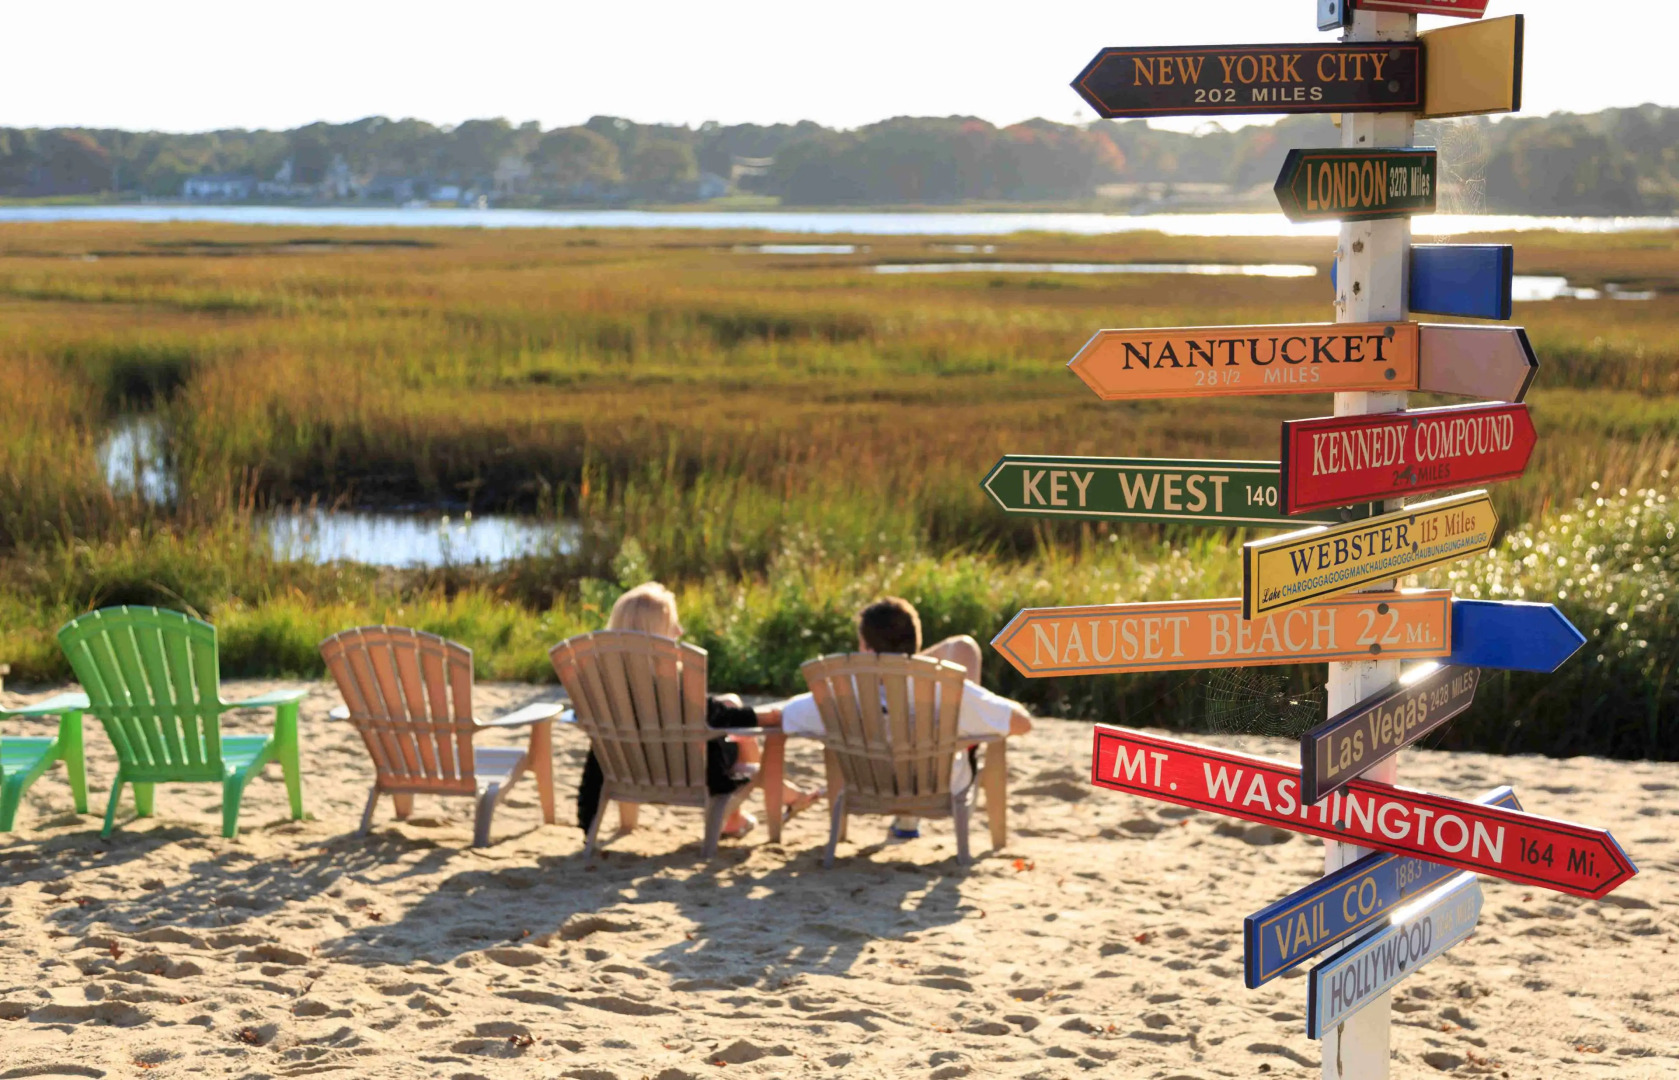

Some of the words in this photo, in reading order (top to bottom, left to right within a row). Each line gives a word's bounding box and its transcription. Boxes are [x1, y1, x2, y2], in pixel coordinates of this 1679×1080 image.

[1132, 56, 1205, 86] NEW
[1218, 54, 1303, 84] YORK
[1317, 52, 1388, 82] CITY
[1194, 88, 1236, 103] 202
[1252, 87, 1323, 102] MILES
[1306, 161, 1387, 209] LONDON
[1389, 167, 1407, 198] 3278
[1410, 167, 1430, 198] Miles
[1121, 335, 1393, 370] NANTUCKET
[1195, 369, 1218, 386] 28
[1264, 366, 1320, 384] MILES
[1312, 425, 1409, 476] KENNEDY
[1414, 414, 1514, 463] COMPOUND
[1023, 469, 1095, 507] KEY
[1118, 473, 1229, 513] WEST
[1418, 463, 1451, 483] MILES
[1289, 523, 1410, 577] WEBSTER
[1421, 519, 1438, 544] 115
[1445, 510, 1476, 537] Miles
[1262, 589, 1281, 604] Lake
[1032, 616, 1190, 665] NAUSET
[1208, 608, 1338, 656] BEACH
[1356, 608, 1401, 646] 22
[1405, 622, 1437, 644] Mi.
[1327, 729, 1364, 778] Las
[1368, 691, 1428, 751] Vegas
[1430, 684, 1449, 711] 2428
[1452, 669, 1474, 698] MILES
[1112, 744, 1177, 791] MT.
[1520, 837, 1554, 868] 164
[1567, 853, 1600, 880] Mi.
[1275, 901, 1330, 960] VAIL
[1343, 877, 1383, 923] CO.
[1395, 858, 1422, 891] 1883
[1330, 916, 1432, 1018] HOLLYWOOD
